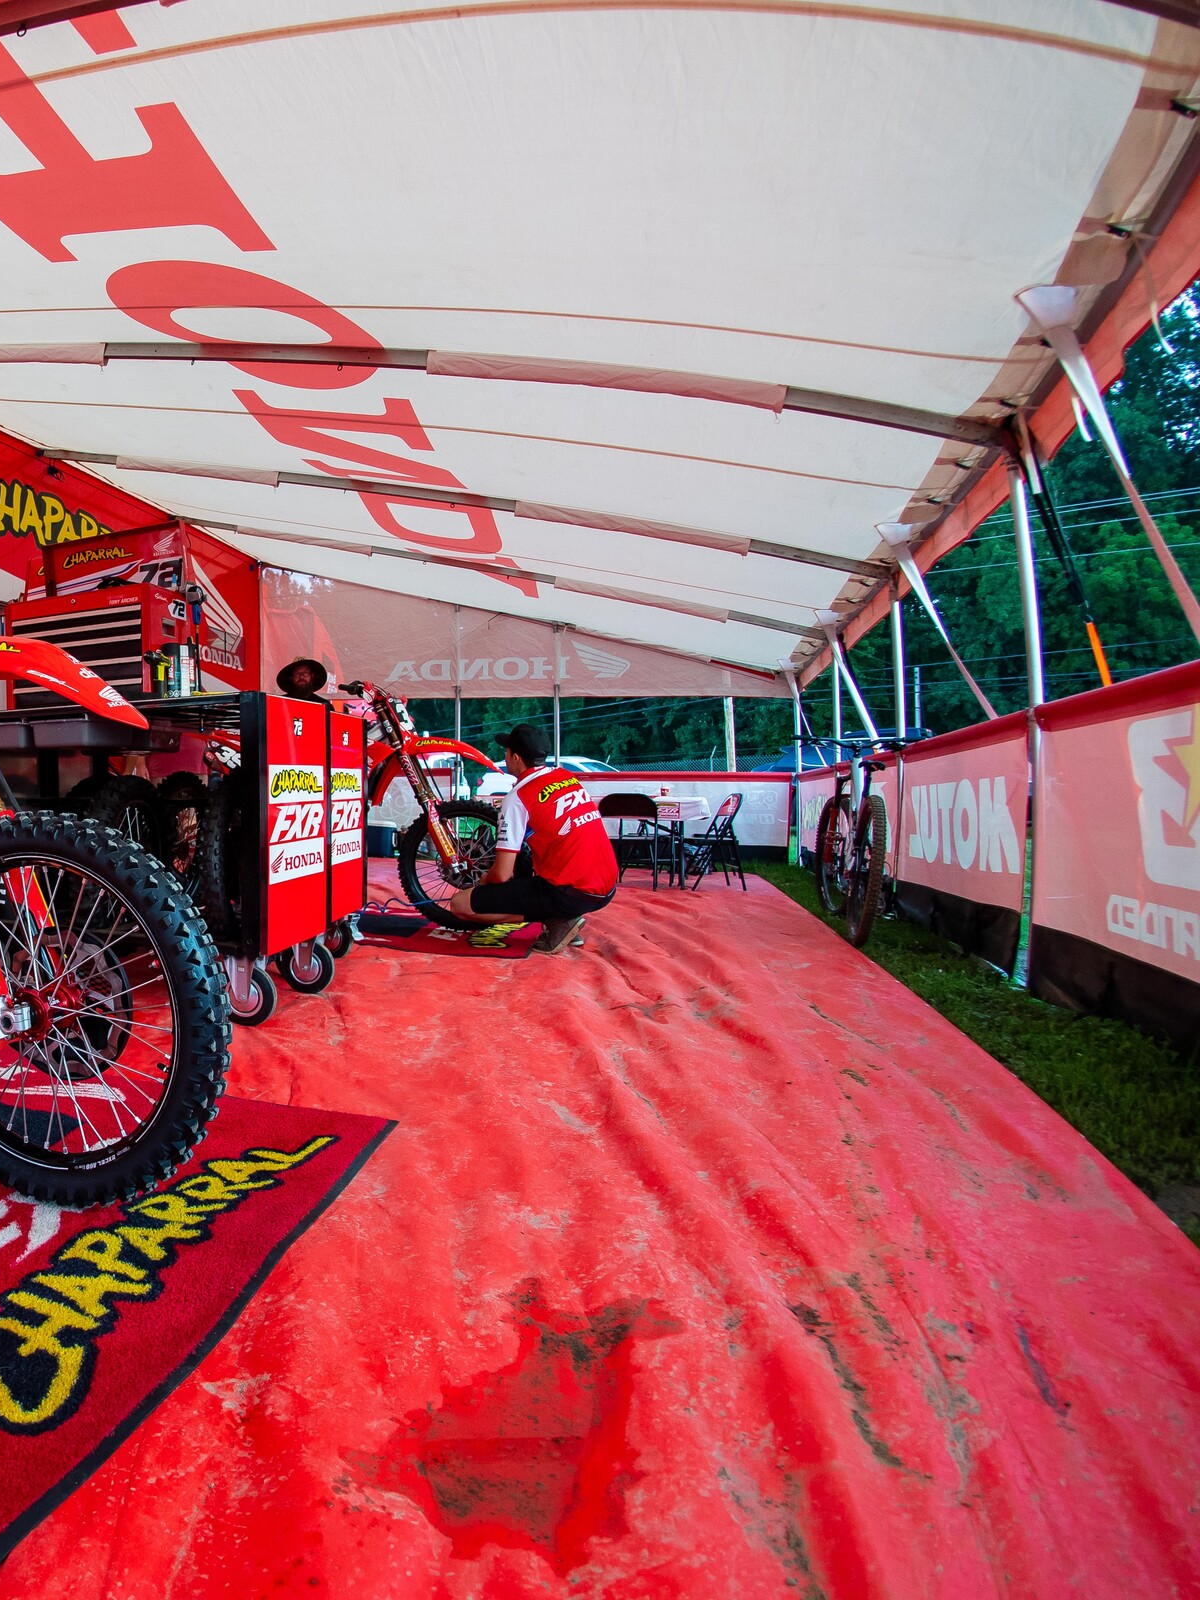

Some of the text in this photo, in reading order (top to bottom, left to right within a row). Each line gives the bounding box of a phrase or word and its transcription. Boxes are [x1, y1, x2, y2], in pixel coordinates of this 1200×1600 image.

[62, 547, 133, 569] CHAPARRAL
[173, 600, 185, 617] 72
[271, 769, 323, 798] CHAPARRAL
[270, 803, 324, 843] FXR
[332, 801, 362, 832] FXR
[336, 840, 361, 856] HONDA
[284, 852, 323, 871] HONDA
